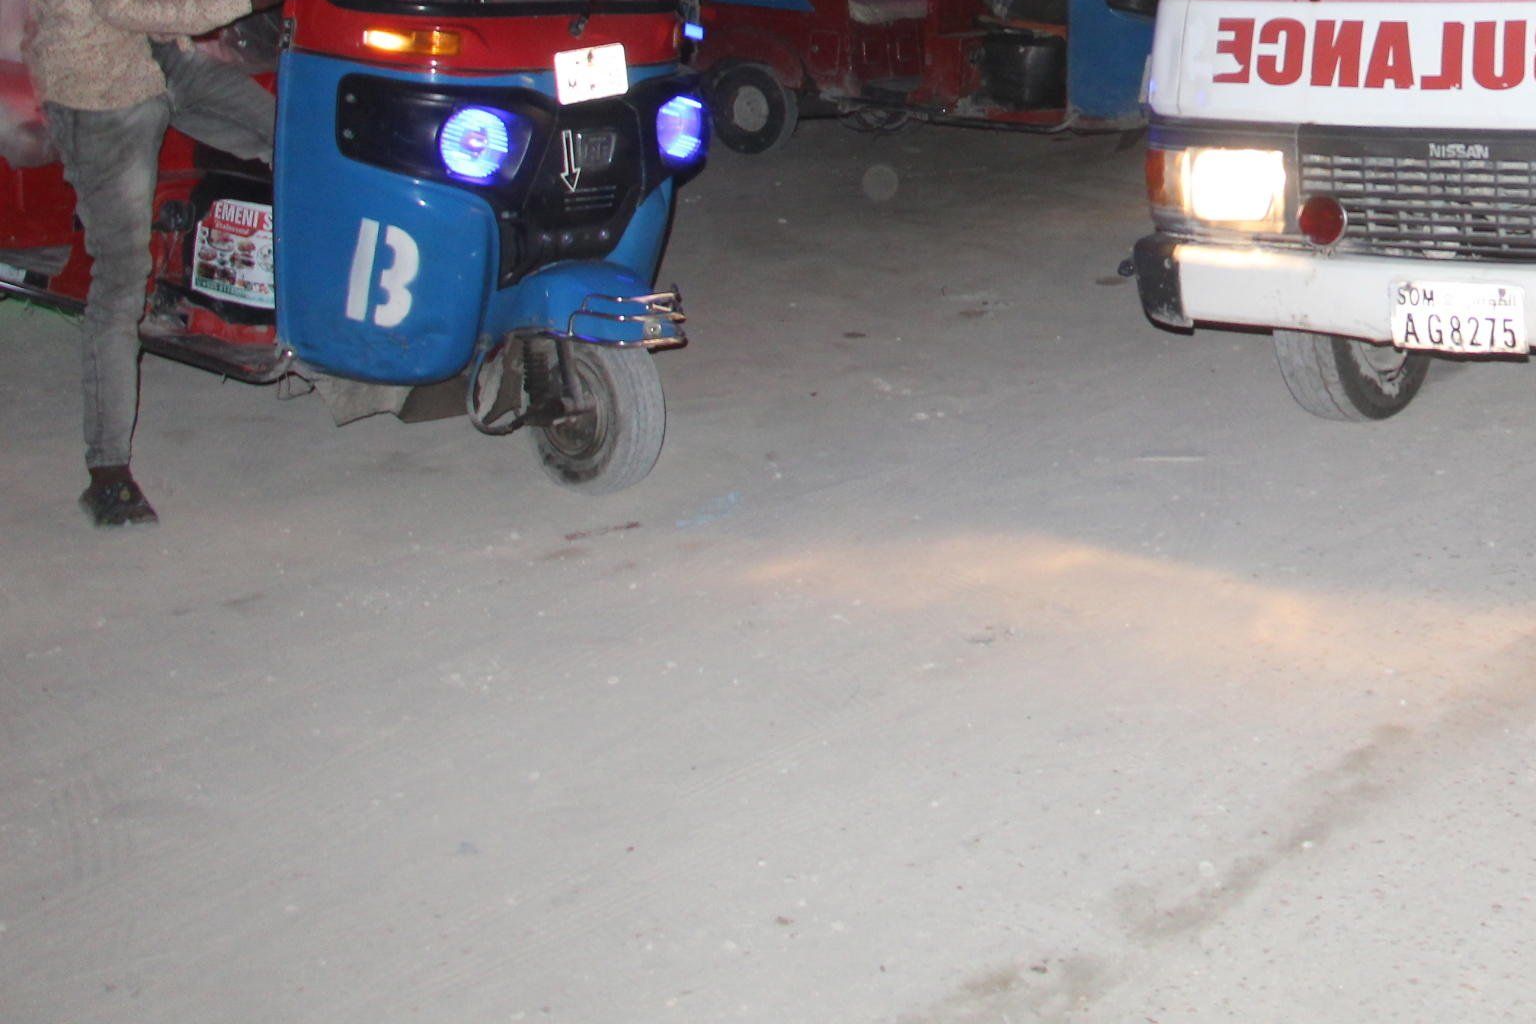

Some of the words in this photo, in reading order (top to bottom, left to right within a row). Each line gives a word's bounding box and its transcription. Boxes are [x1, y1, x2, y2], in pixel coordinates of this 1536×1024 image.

[1428, 143, 1489, 159] NISSAN
[212, 201, 259, 229] EMENI
[345, 217, 421, 328] B
[1397, 286, 1434, 307] SOM
[1404, 313, 1517, 349] AG8275
